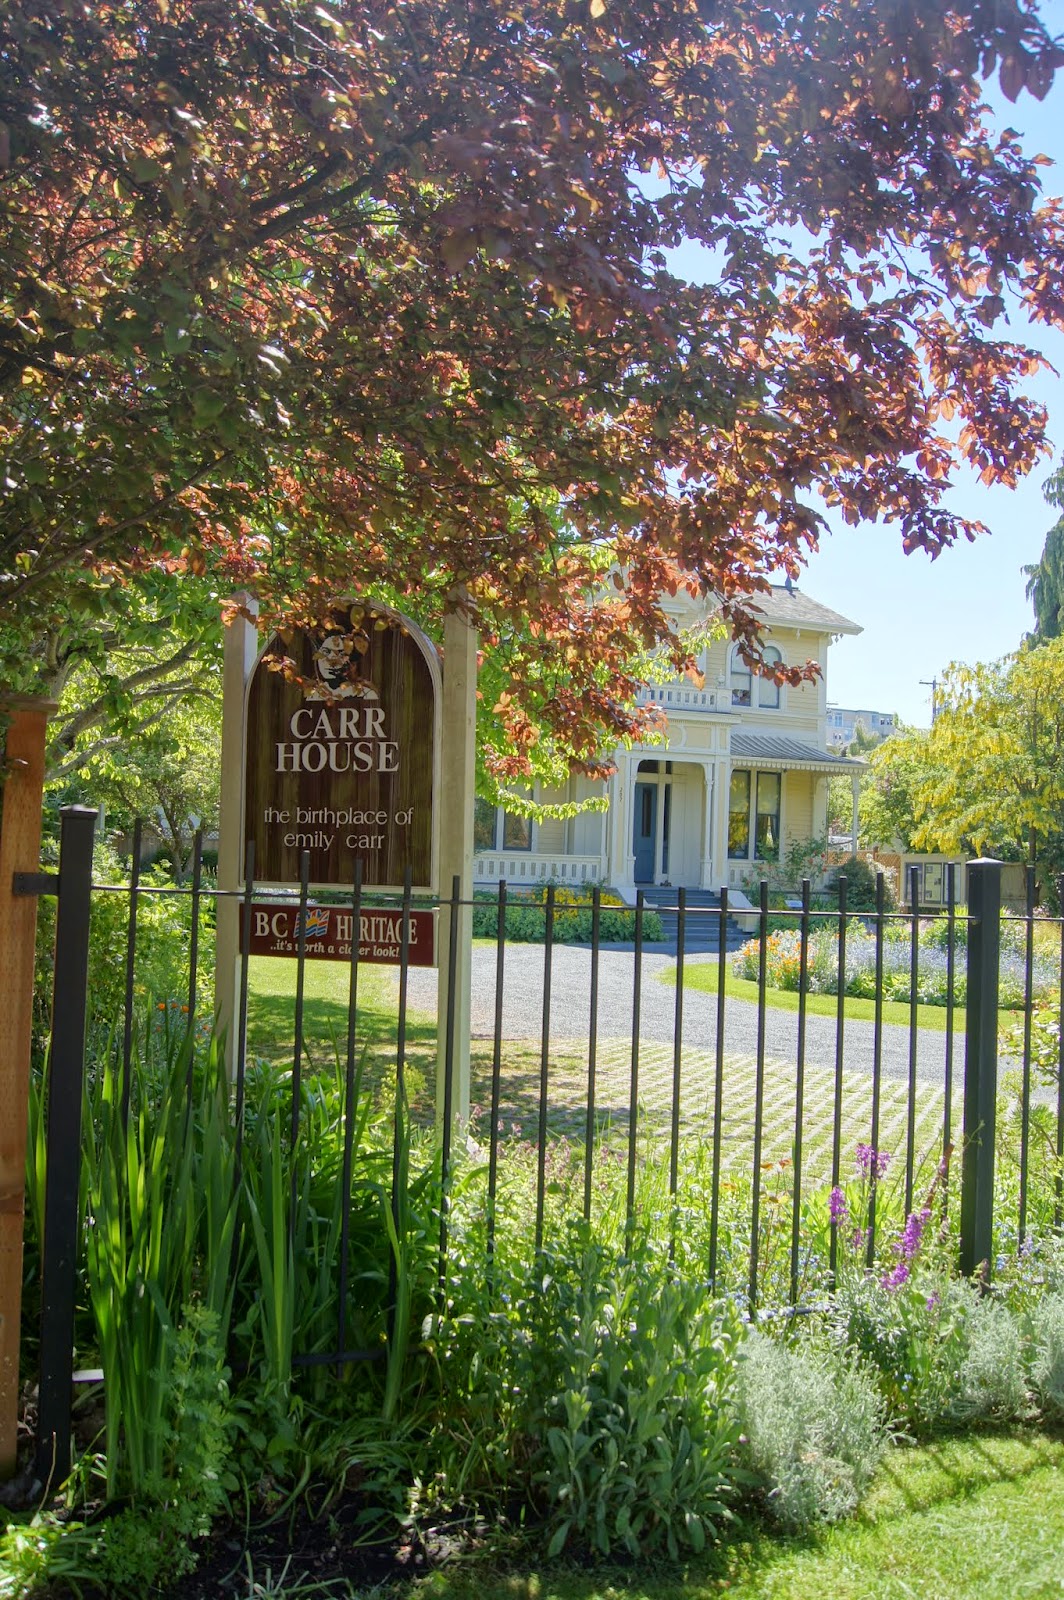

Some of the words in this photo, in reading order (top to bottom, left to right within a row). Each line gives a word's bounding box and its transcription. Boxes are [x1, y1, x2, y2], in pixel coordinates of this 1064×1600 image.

[290, 707, 387, 739] CARR
[275, 742, 399, 772] HOUSE
[264, 807, 290, 824] the
[296, 807, 387, 828] birthplace
[394, 808, 414, 826] of
[283, 831, 335, 851] emily
[346, 834, 386, 849] carr
[254, 911, 288, 938] BC
[327, 945, 336, 954] a
[338, 944, 370, 956] cloer
[372, 945, 401, 958] look!
